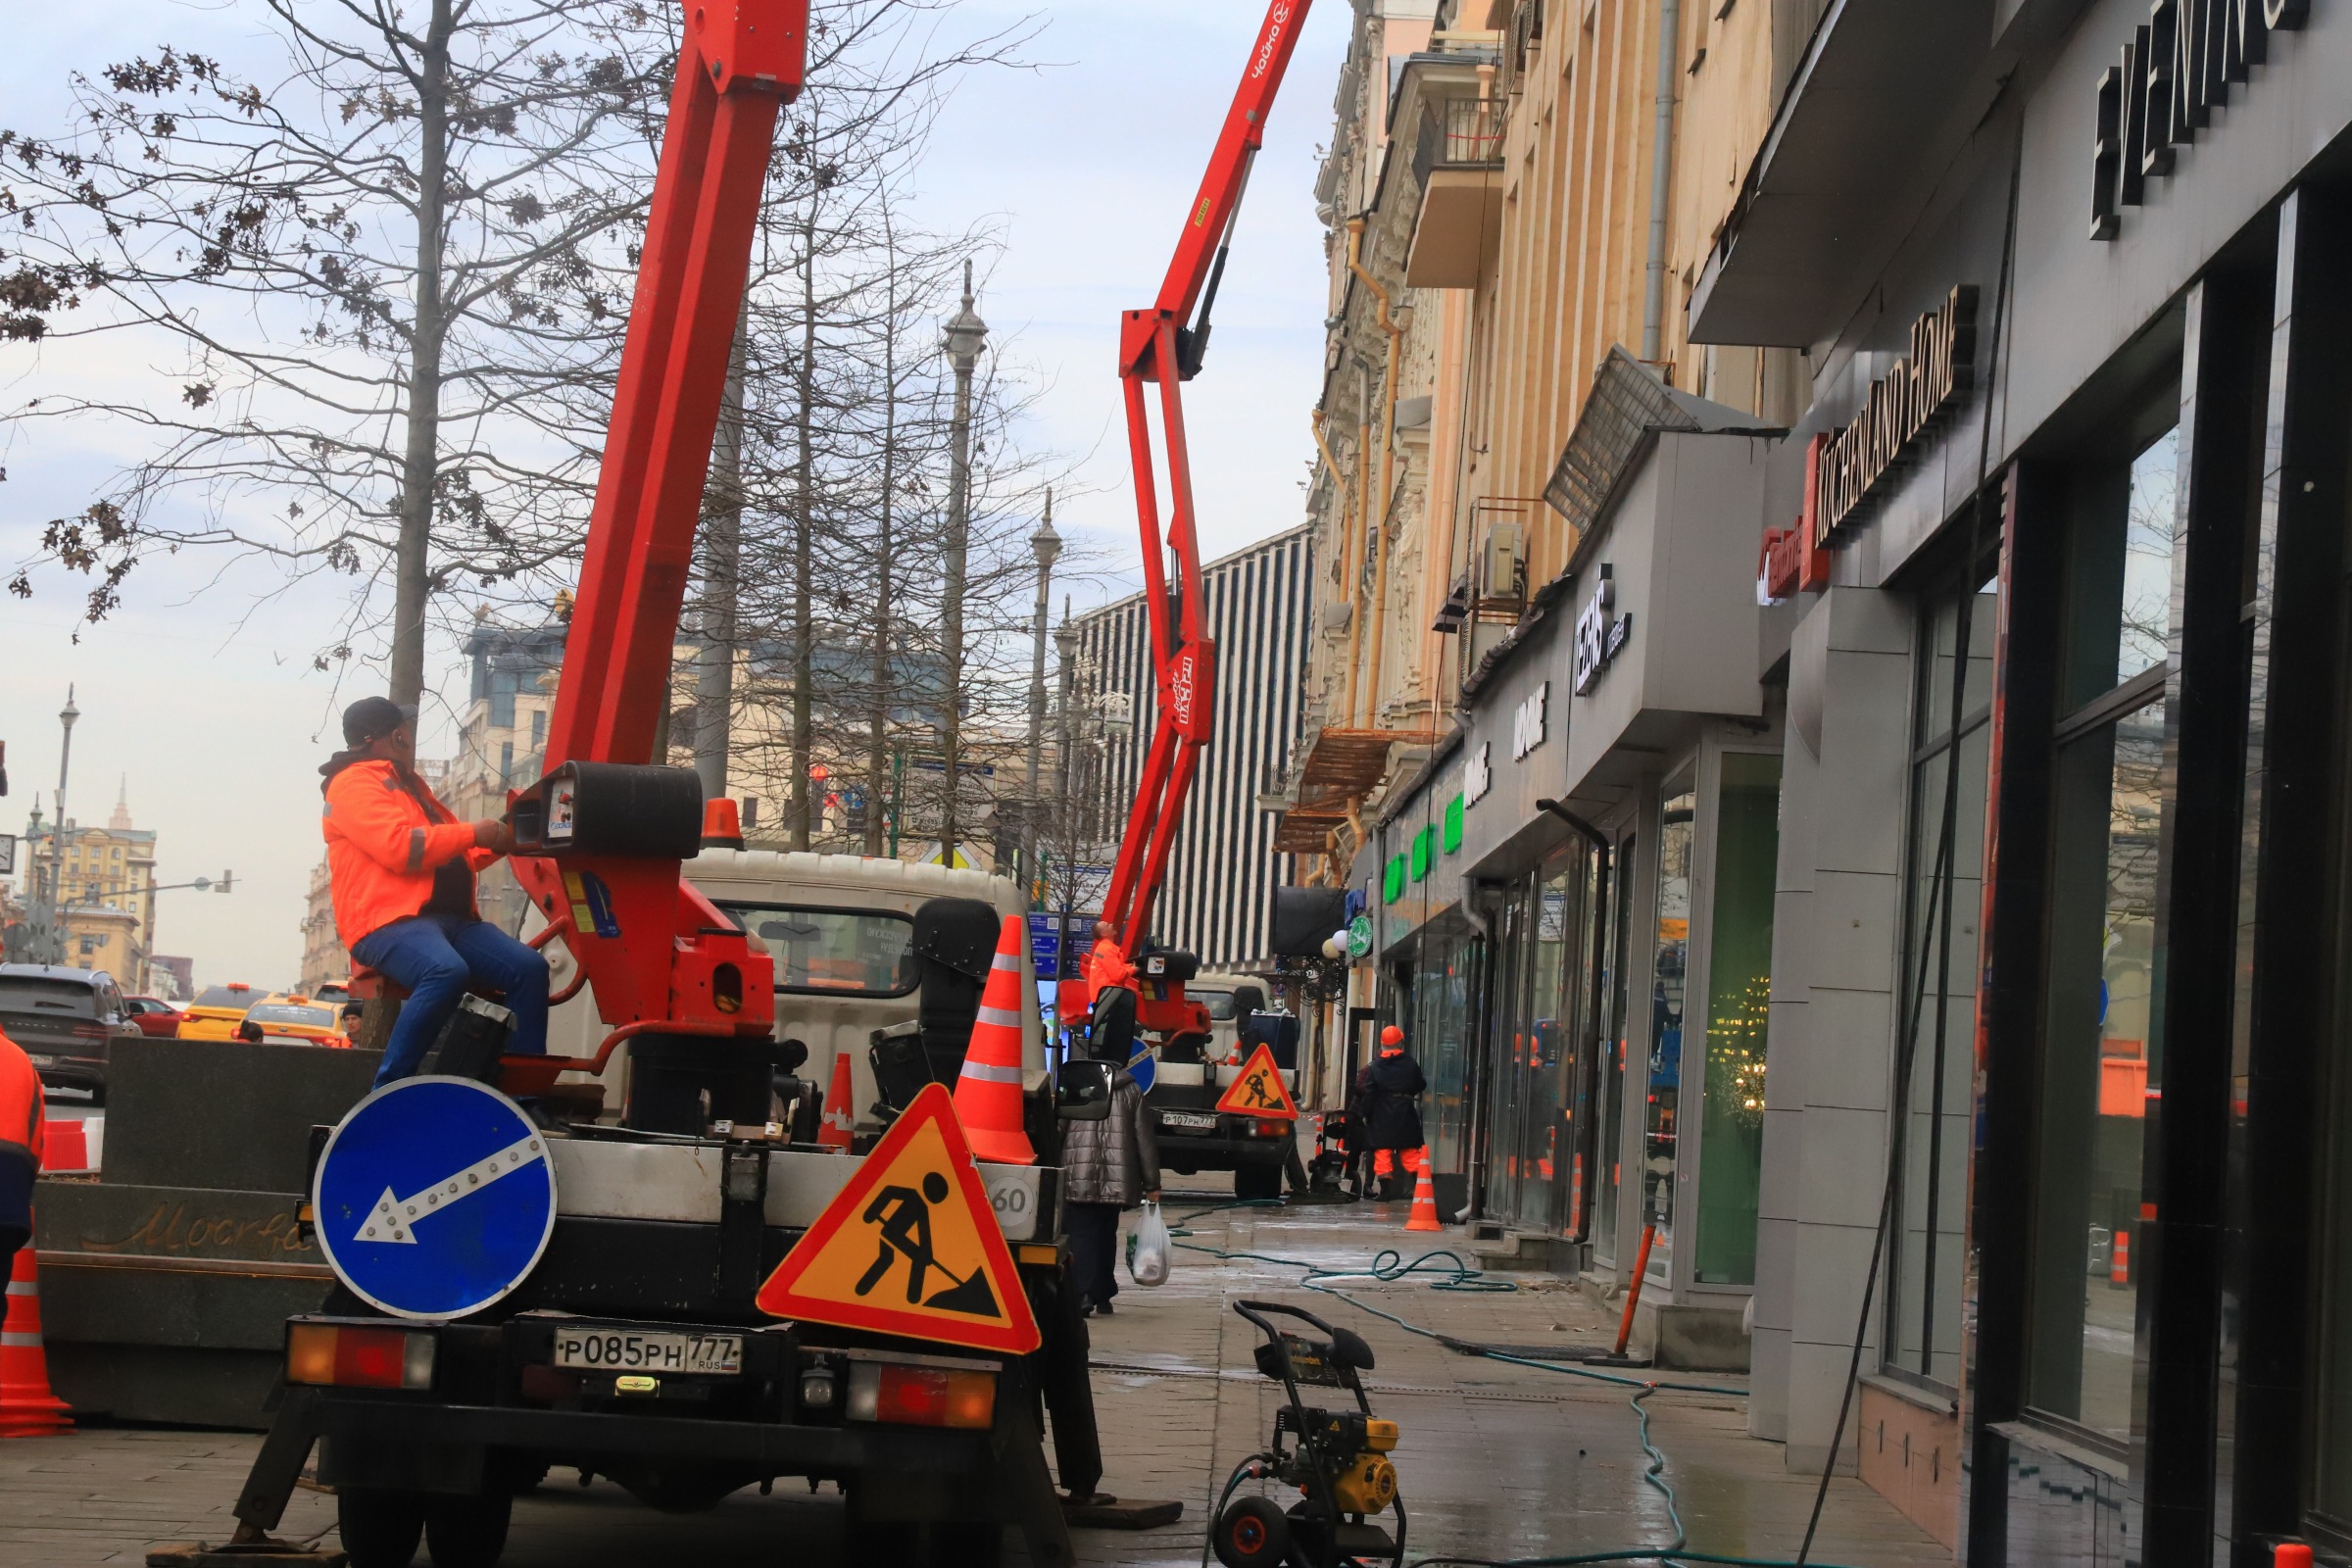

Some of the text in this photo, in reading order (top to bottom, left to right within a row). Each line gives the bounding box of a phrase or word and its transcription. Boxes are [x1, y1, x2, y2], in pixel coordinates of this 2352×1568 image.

[1250, 24, 1281, 78] Чайка
[2088, 0, 2298, 241] EVENI
[1815, 283, 1962, 550] KÜCHENLAND HOME
[992, 1188, 1026, 1213] 60
[78, 1199, 314, 1261] Москва
[688, 1338, 734, 1361] 777
[698, 1360, 721, 1370] RUS
